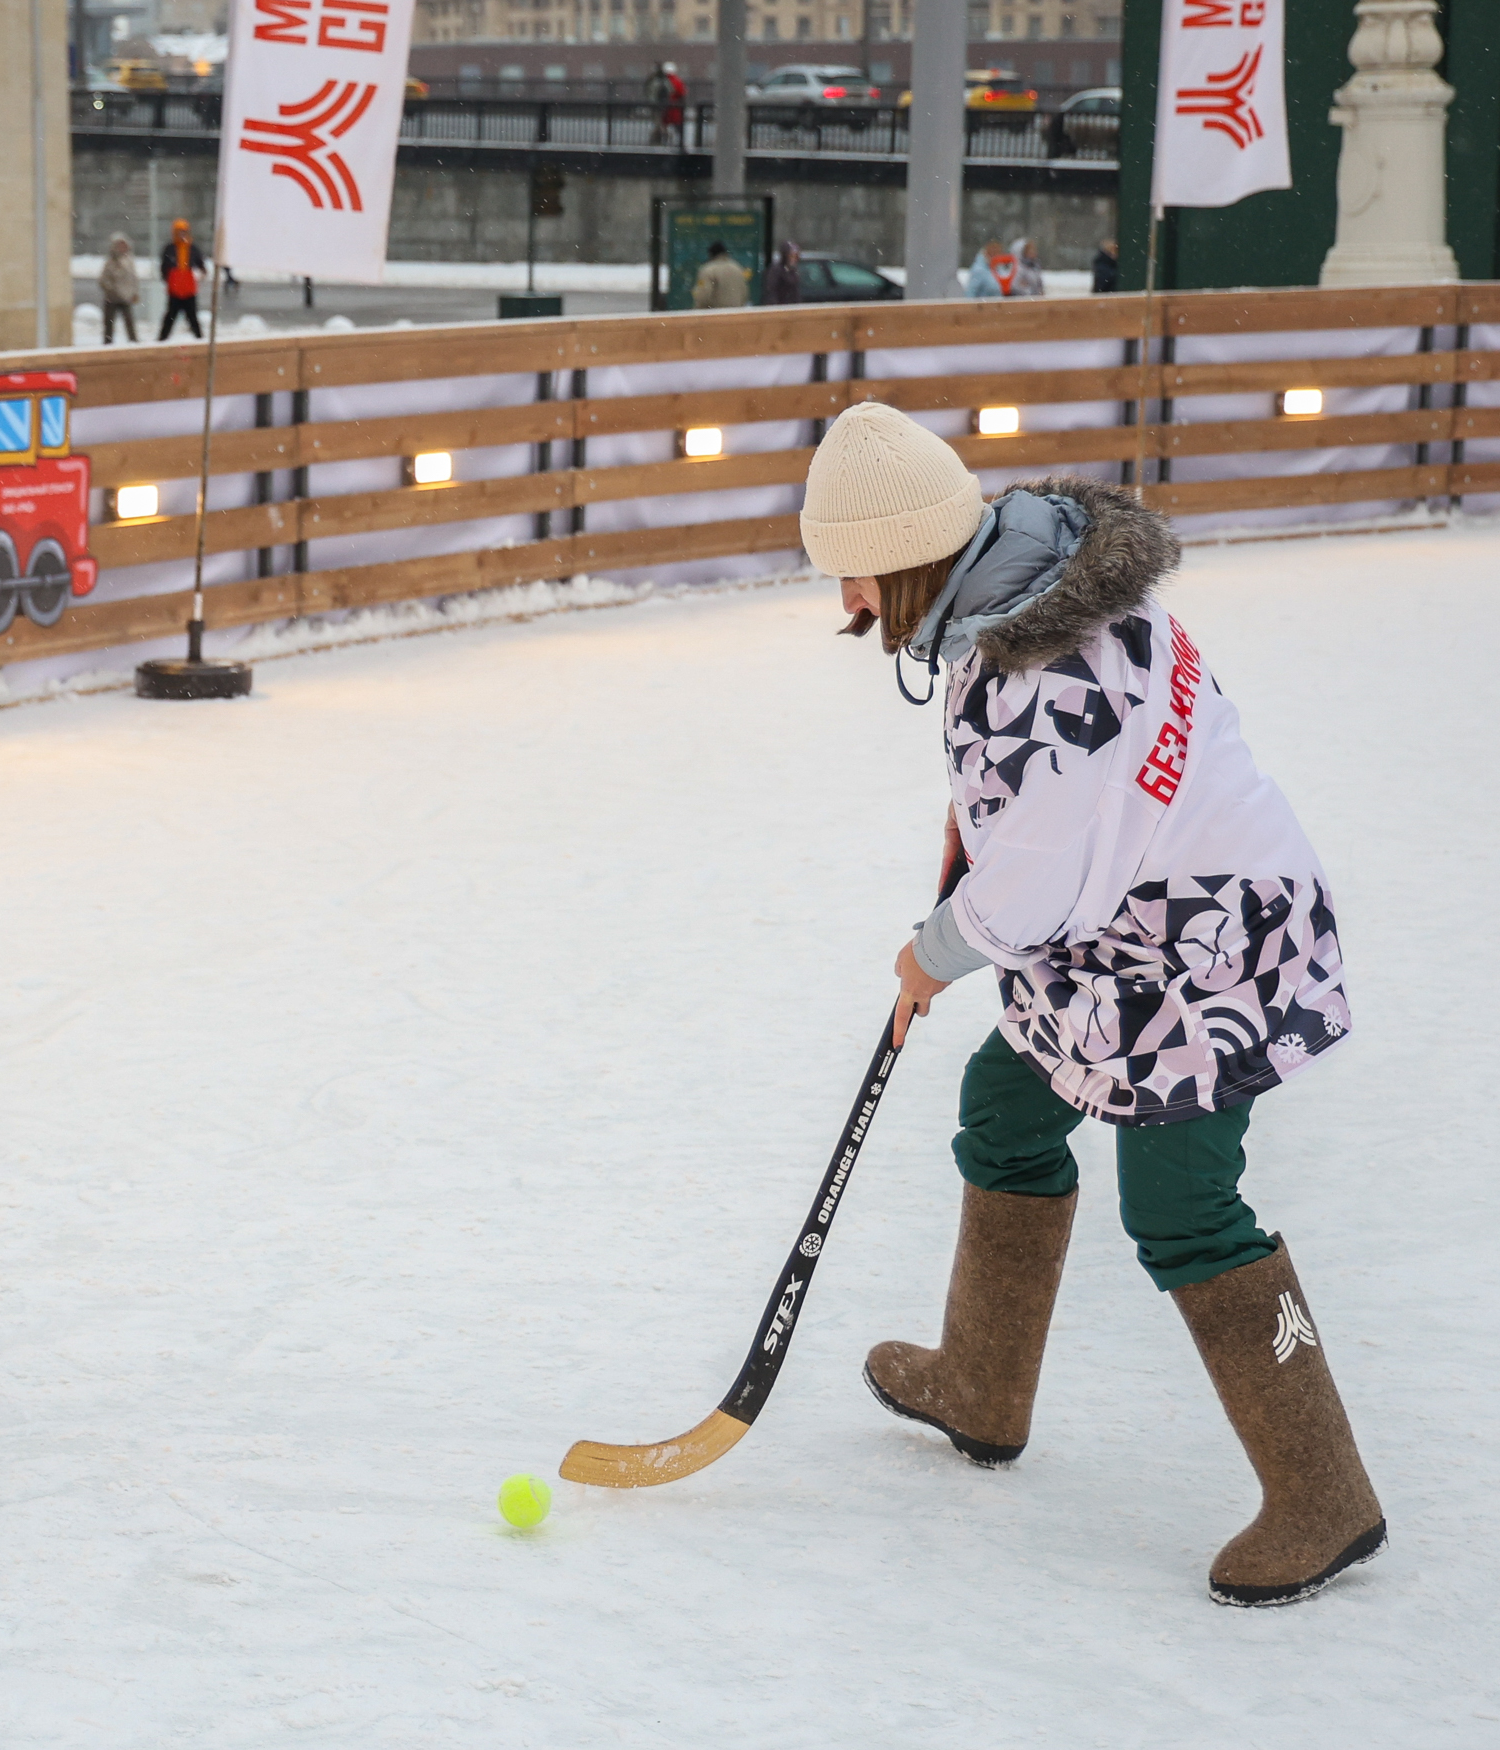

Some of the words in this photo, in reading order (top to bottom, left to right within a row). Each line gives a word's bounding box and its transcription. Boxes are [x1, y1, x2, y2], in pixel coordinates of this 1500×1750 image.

[1135, 721, 1188, 807] БЕЗ
[817, 1144, 857, 1224] ORANGE
[851, 1099, 876, 1143] HAIL
[763, 1272, 804, 1356] STEX
